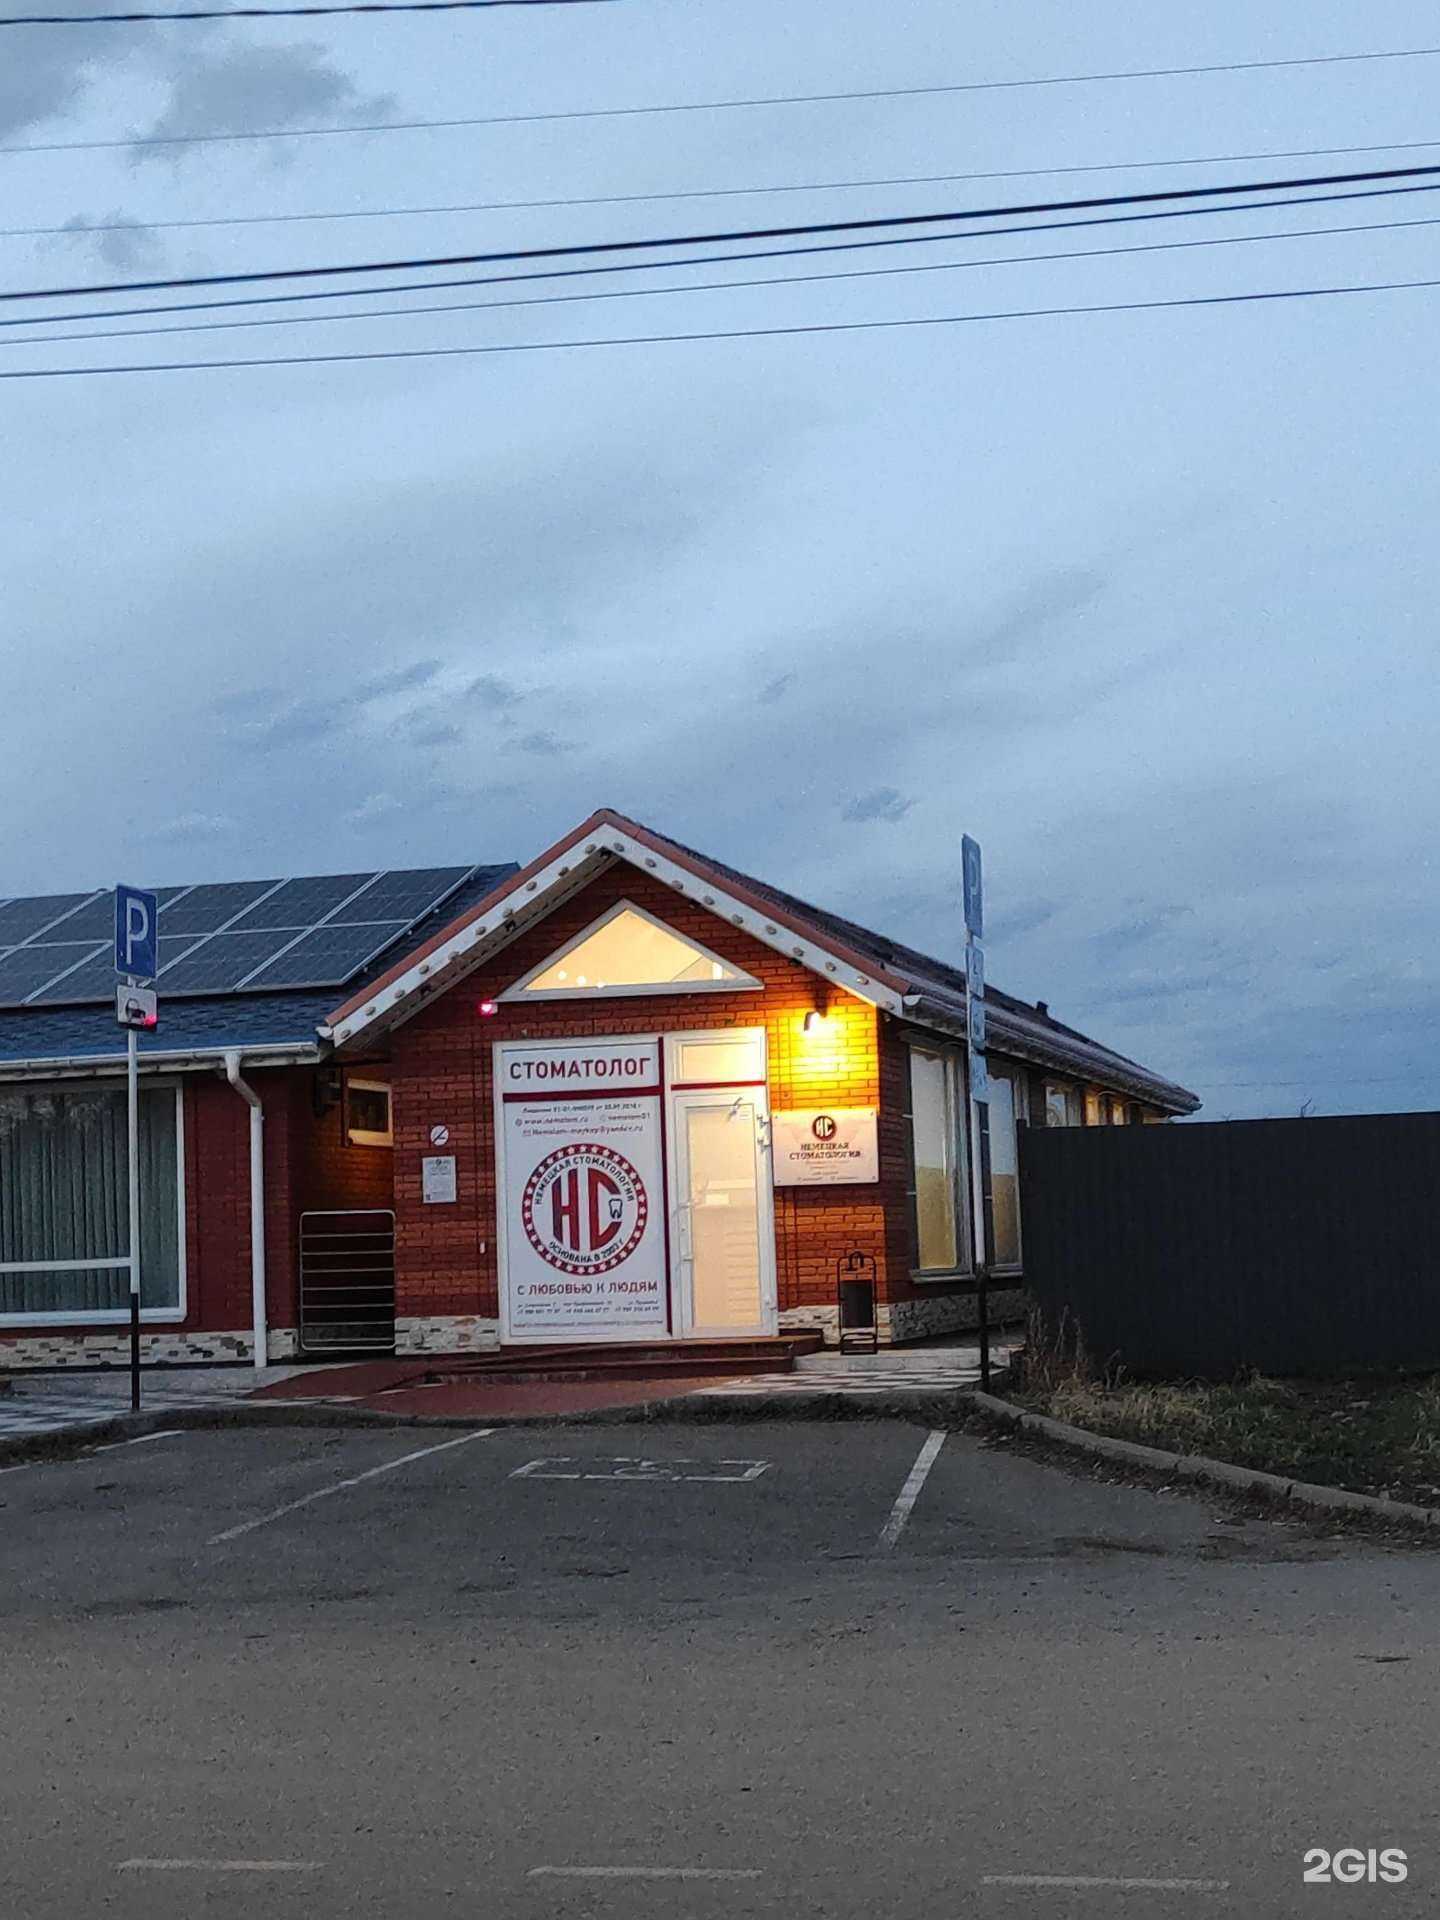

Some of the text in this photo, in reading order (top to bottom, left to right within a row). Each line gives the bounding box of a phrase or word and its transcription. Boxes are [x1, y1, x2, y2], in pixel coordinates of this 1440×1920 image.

[126, 897, 149, 965] P
[510, 1057, 651, 1080] СТОМАТОЛОГ
[789, 1150, 861, 1161] СТОМАТОЛОГИЯ
[800, 1142, 849, 1151] НЕМЕЦКАЯ
[535, 1155, 635, 1206] НЕМЕЦКАЯ СТОМАТОЛОГИЯ
[548, 1240, 594, 1263] ОСНОВАНА
[517, 1280, 659, 1296] С ЛЮБОВЬЮ К ЛЮДЯМ
